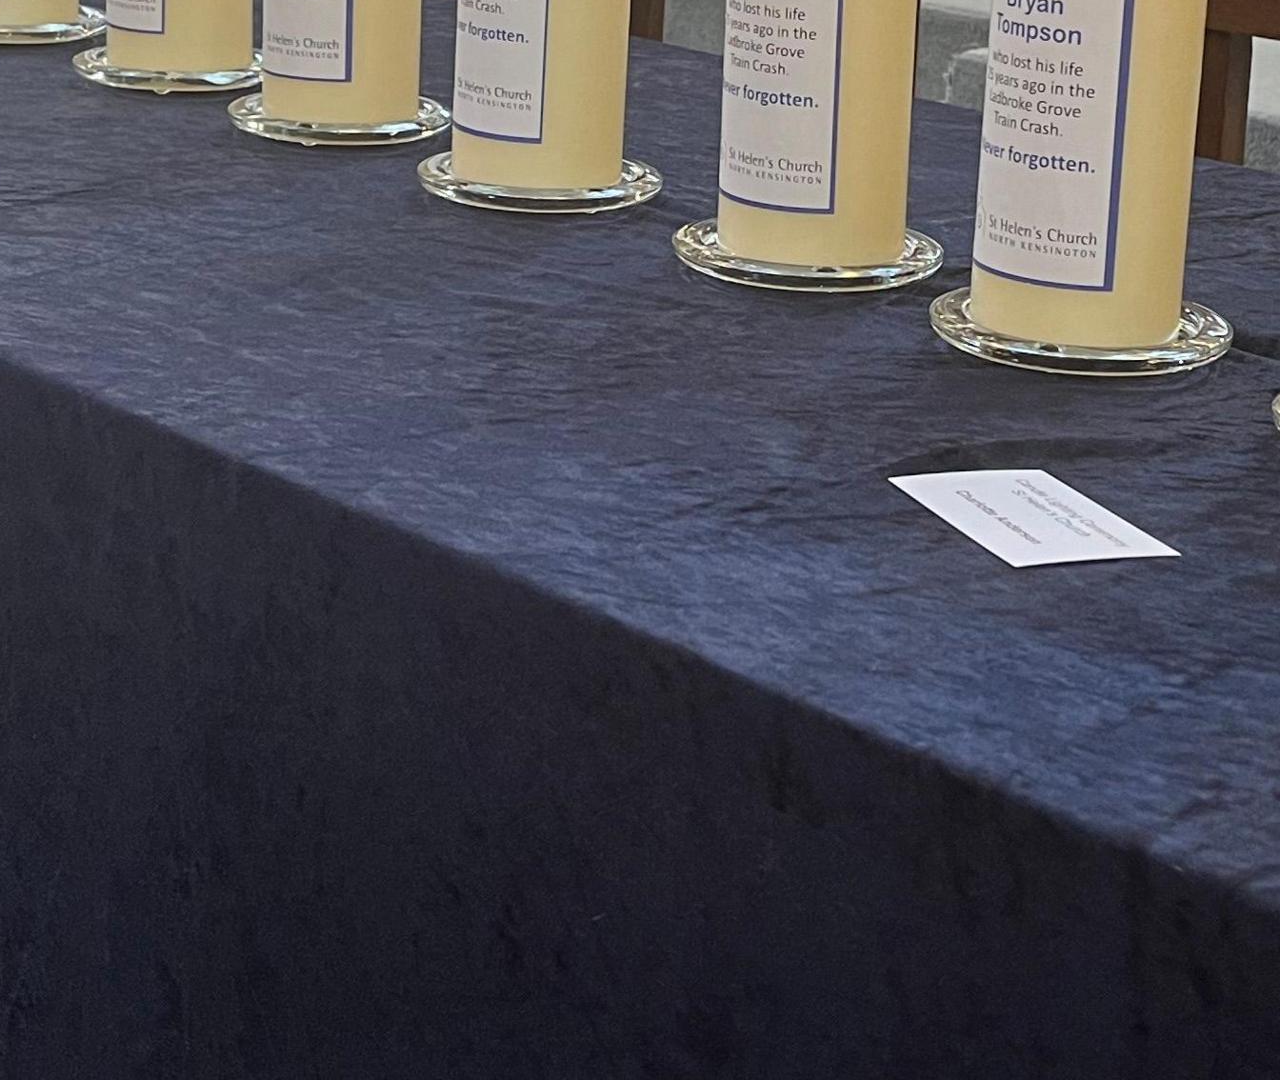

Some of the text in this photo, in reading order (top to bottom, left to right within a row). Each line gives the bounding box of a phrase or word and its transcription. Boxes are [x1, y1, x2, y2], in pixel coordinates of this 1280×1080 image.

[475, 0, 505, 15] Crash.
[743, 0, 760, 16] lost
[764, 2, 781, 19] his
[785, 7, 806, 21] life
[468, 21, 529, 44] forgotten.
[753, 24, 774, 38] ago
[778, 25, 789, 38] in
[794, 27, 817, 41] the
[996, 11, 1082, 45] Tompson
[303, 38, 340, 50] Church
[765, 43, 806, 59] Grove
[752, 59, 790, 76] Crash.
[1011, 54, 1031, 71] lost
[1035, 58, 1055, 74] his
[1060, 61, 1084, 77] life
[494, 87, 532, 102] Church
[743, 84, 819, 108] forgotten.
[1022, 79, 1047, 95] ago
[1050, 81, 1064, 96] in
[1069, 83, 1096, 99] the
[476, 98, 532, 112] KENSINGTON
[1036, 100, 1082, 119] Grove
[993, 110, 1064, 138] Train Crash.
[738, 149, 773, 169] Helen's
[778, 158, 823, 173] Church
[1008, 145, 1096, 174] forgotten.
[755, 169, 822, 185] KENSINGTON
[988, 214, 1097, 246] St Helen's Church
[1021, 240, 1097, 259] KENSINGTON
